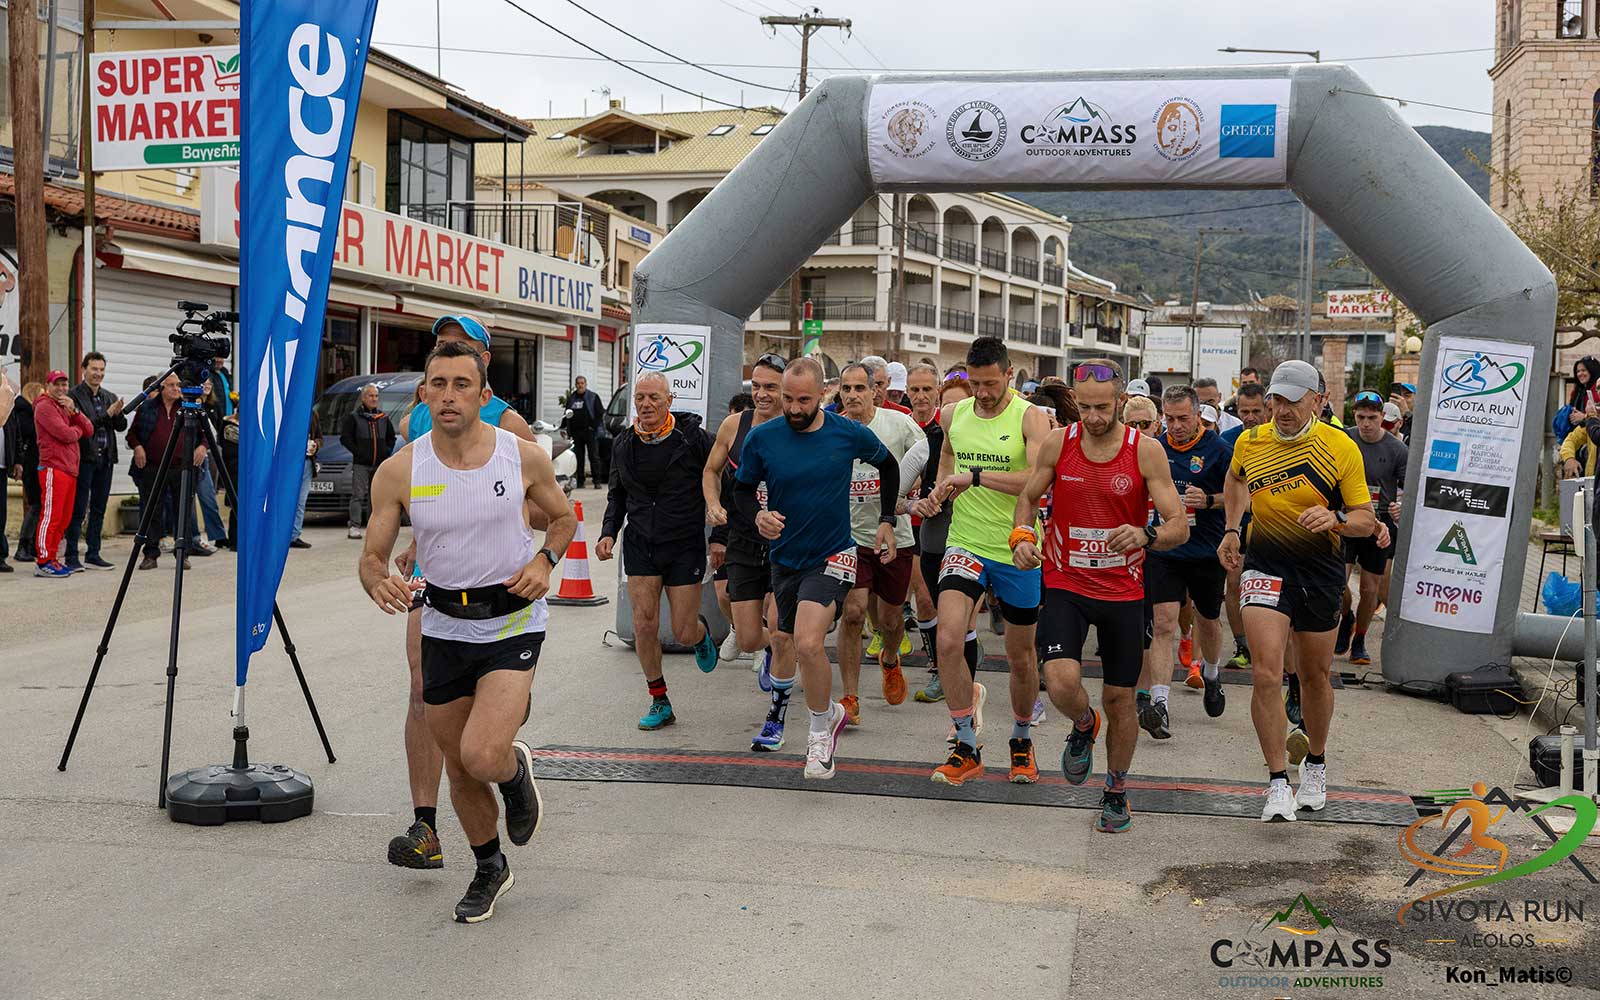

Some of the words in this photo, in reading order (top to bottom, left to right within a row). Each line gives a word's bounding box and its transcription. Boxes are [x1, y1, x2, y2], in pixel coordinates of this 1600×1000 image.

[97, 55, 205, 98] SUPER
[97, 98, 240, 142] MARKET
[1020, 125, 1136, 144] COMPASS
[1221, 125, 1275, 136] GREECE
[385, 220, 504, 294] MARKET
[519, 266, 594, 312] ΒΑΓΓΕΛΗΣ
[673, 379, 697, 389] RUN
[1442, 399, 1486, 413] SIVOTA
[1489, 404, 1514, 416] RUN
[1460, 415, 1493, 425] AEOLOS
[957, 452, 974, 460] BOAT
[977, 453, 1010, 463] RENTALS
[850, 481, 877, 491] 2023
[1262, 471, 1289, 486] SPO
[1439, 485, 1473, 498] FRAME
[1464, 498, 1490, 510] REEL
[1416, 581, 1482, 604] STRONG
[1434, 600, 1459, 615] me
